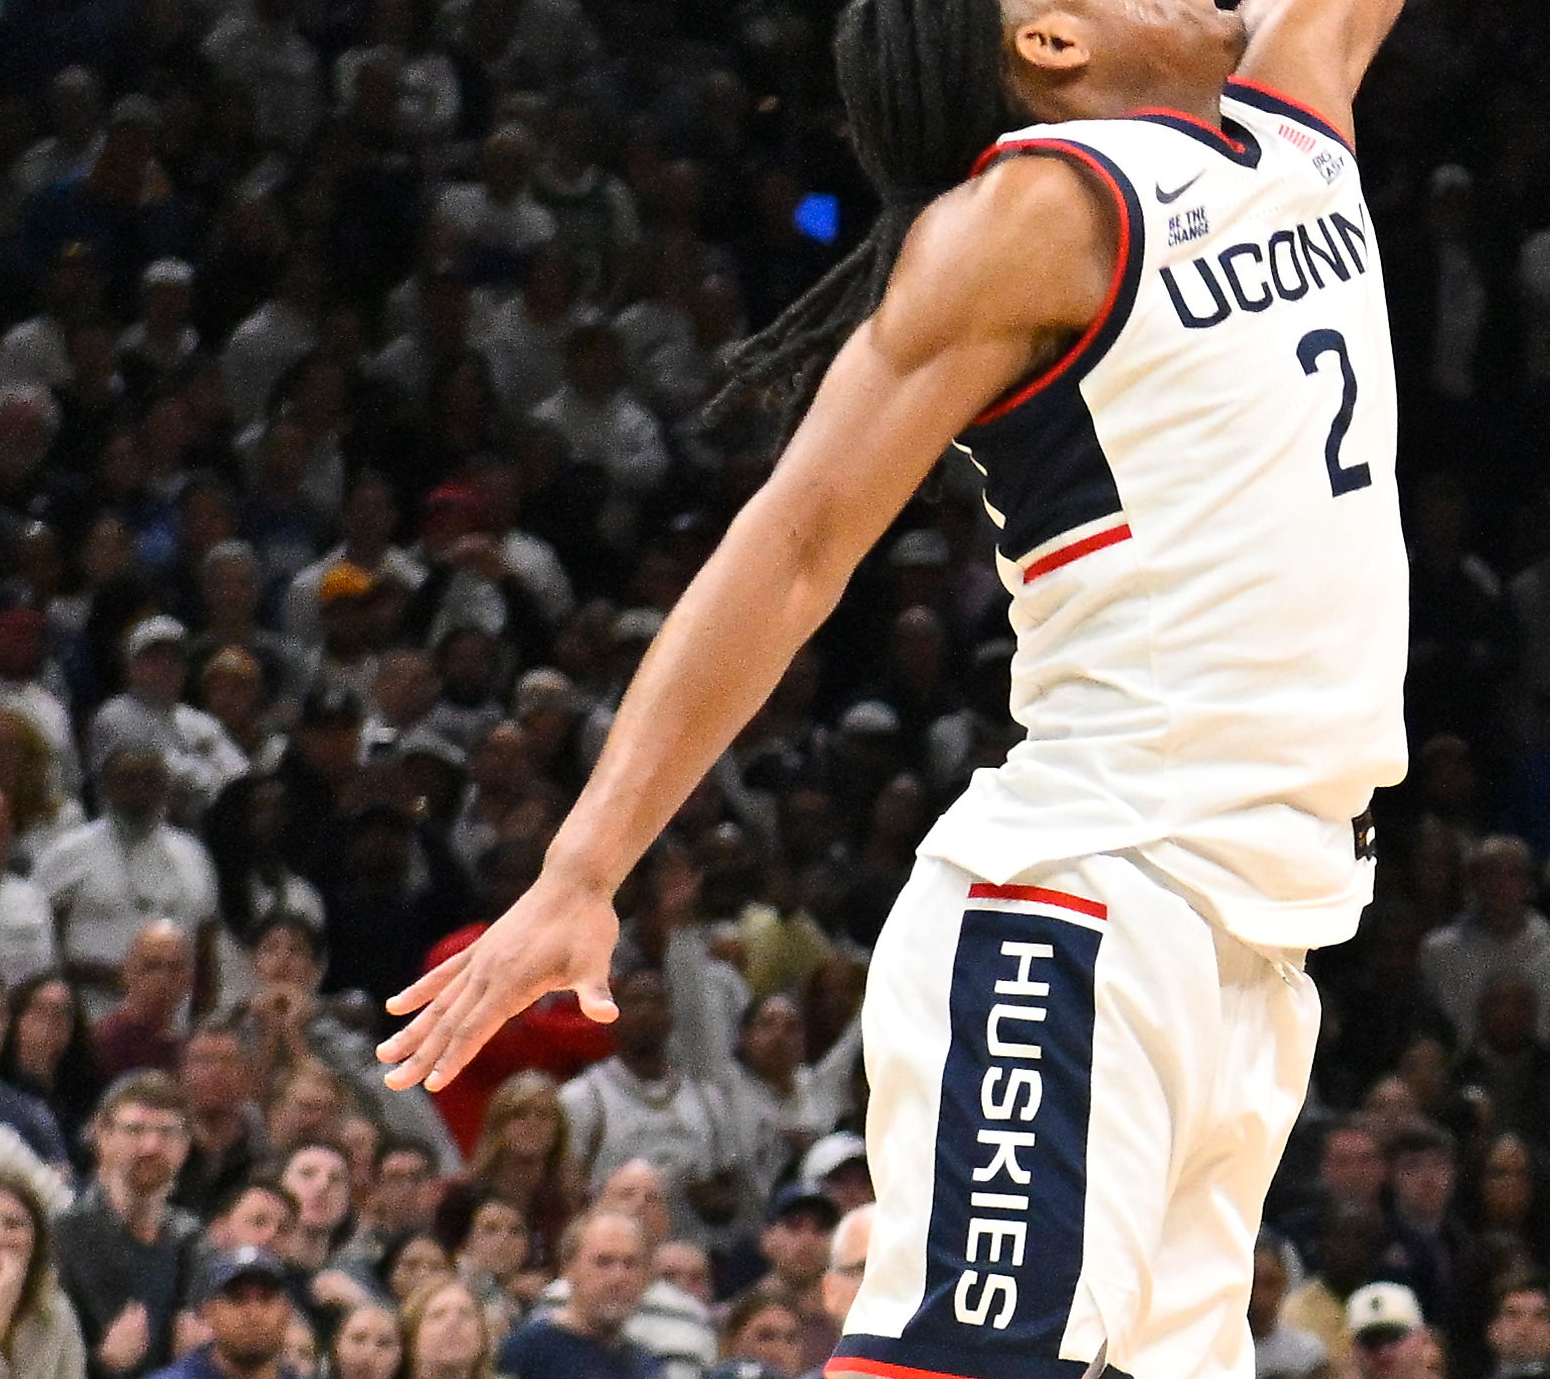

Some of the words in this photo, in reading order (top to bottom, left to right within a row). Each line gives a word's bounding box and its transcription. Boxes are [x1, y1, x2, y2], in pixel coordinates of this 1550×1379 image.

[1160, 204, 1369, 329] UCONN
[1295, 328, 1373, 498] 2
[953, 940, 1055, 1331] HUSKIES
